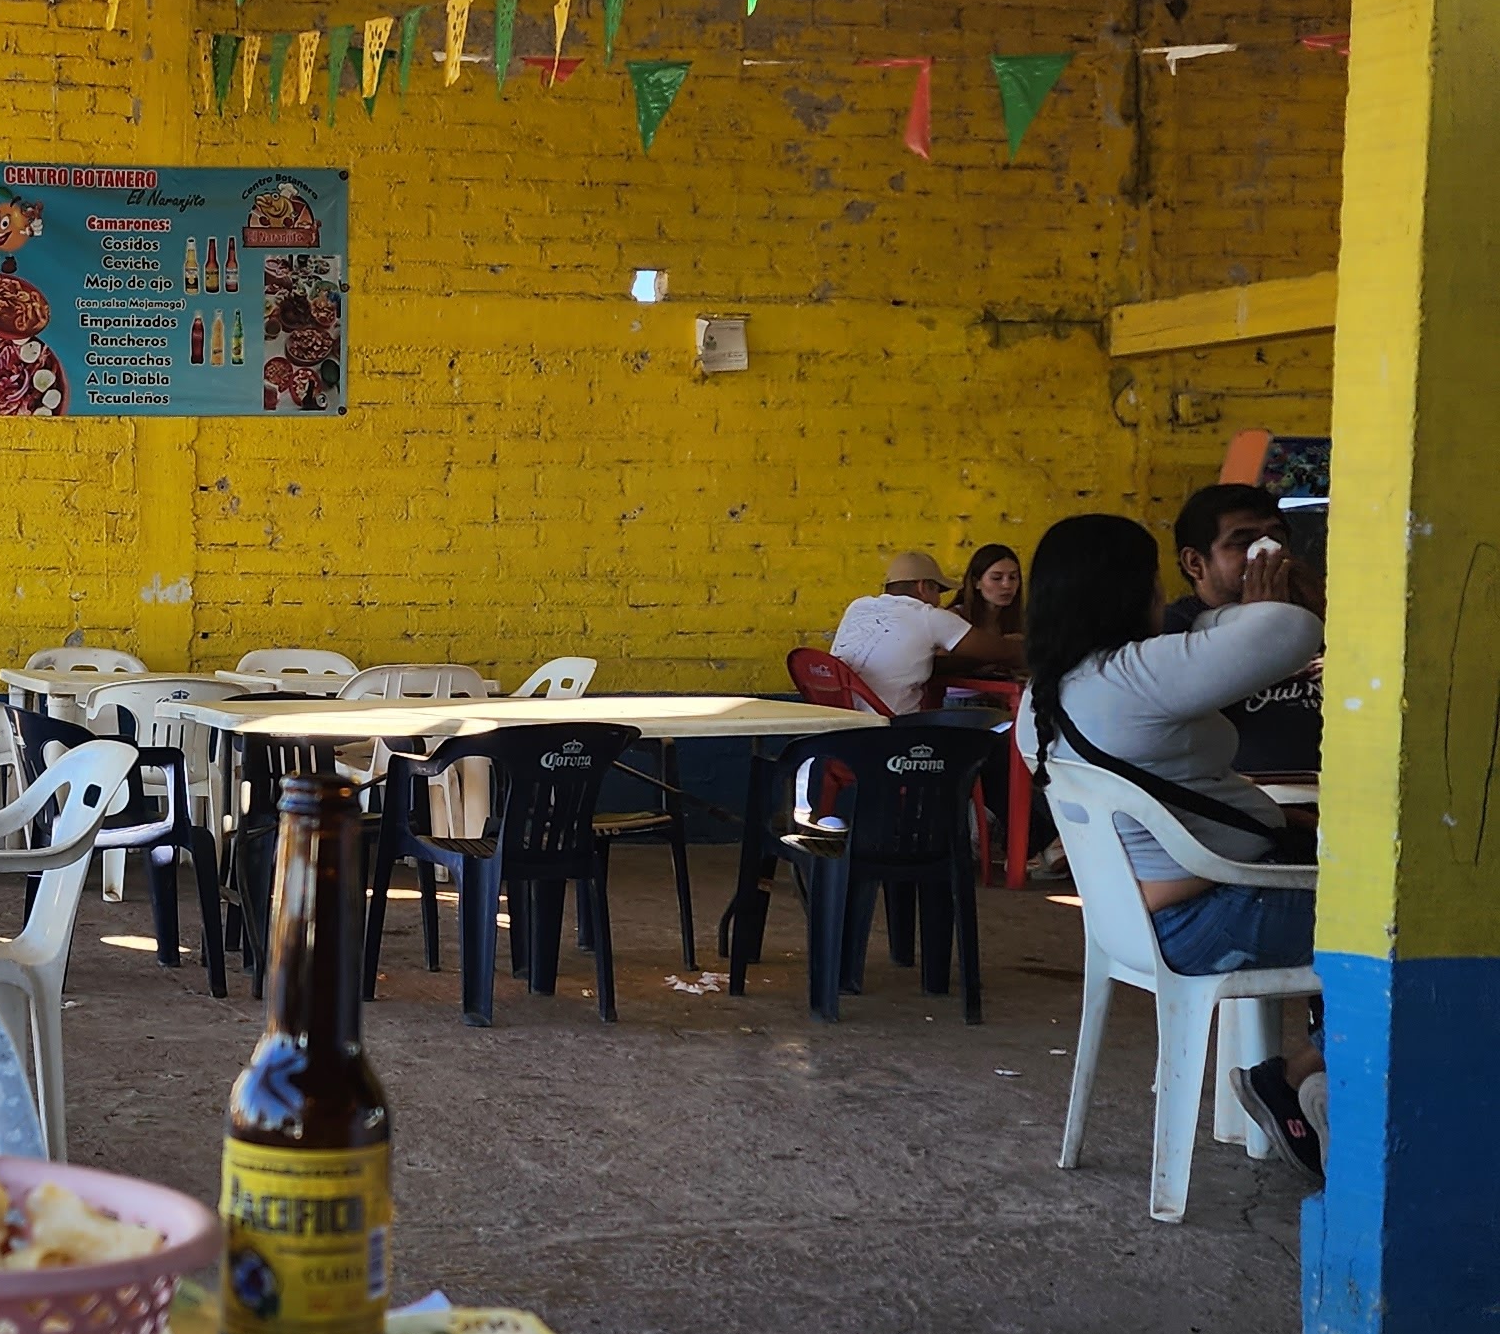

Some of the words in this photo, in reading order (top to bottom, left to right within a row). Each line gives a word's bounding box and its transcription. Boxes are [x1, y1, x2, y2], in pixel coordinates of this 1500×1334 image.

[5, 167, 69, 186] CENTRO
[73, 169, 158, 188] BOTANERO
[242, 176, 273, 200] Centro
[276, 173, 318, 200] Botanero
[127, 189, 145, 206] El
[147, 190, 206, 212] Naranjito
[86, 215, 171, 232] Camarones:
[102, 236, 160, 251] Cosidos
[102, 255, 160, 270] Ceviche
[85, 274, 122, 291] Mojo
[127, 275, 146, 289] de
[150, 276, 173, 292] ajo
[76, 298, 98, 308] (con
[102, 298, 126, 308] salsa
[80, 314, 178, 329] Empanizados
[90, 333, 167, 347] Rancheros
[85, 352, 172, 366] Cucarachas
[86, 371, 99, 385] A
[103, 371, 117, 385] la
[122, 371, 169, 385] Diabla
[87, 390, 170, 404] Tecualeños
[540, 751, 592, 771] Corona
[887, 755, 945, 775] Corona
